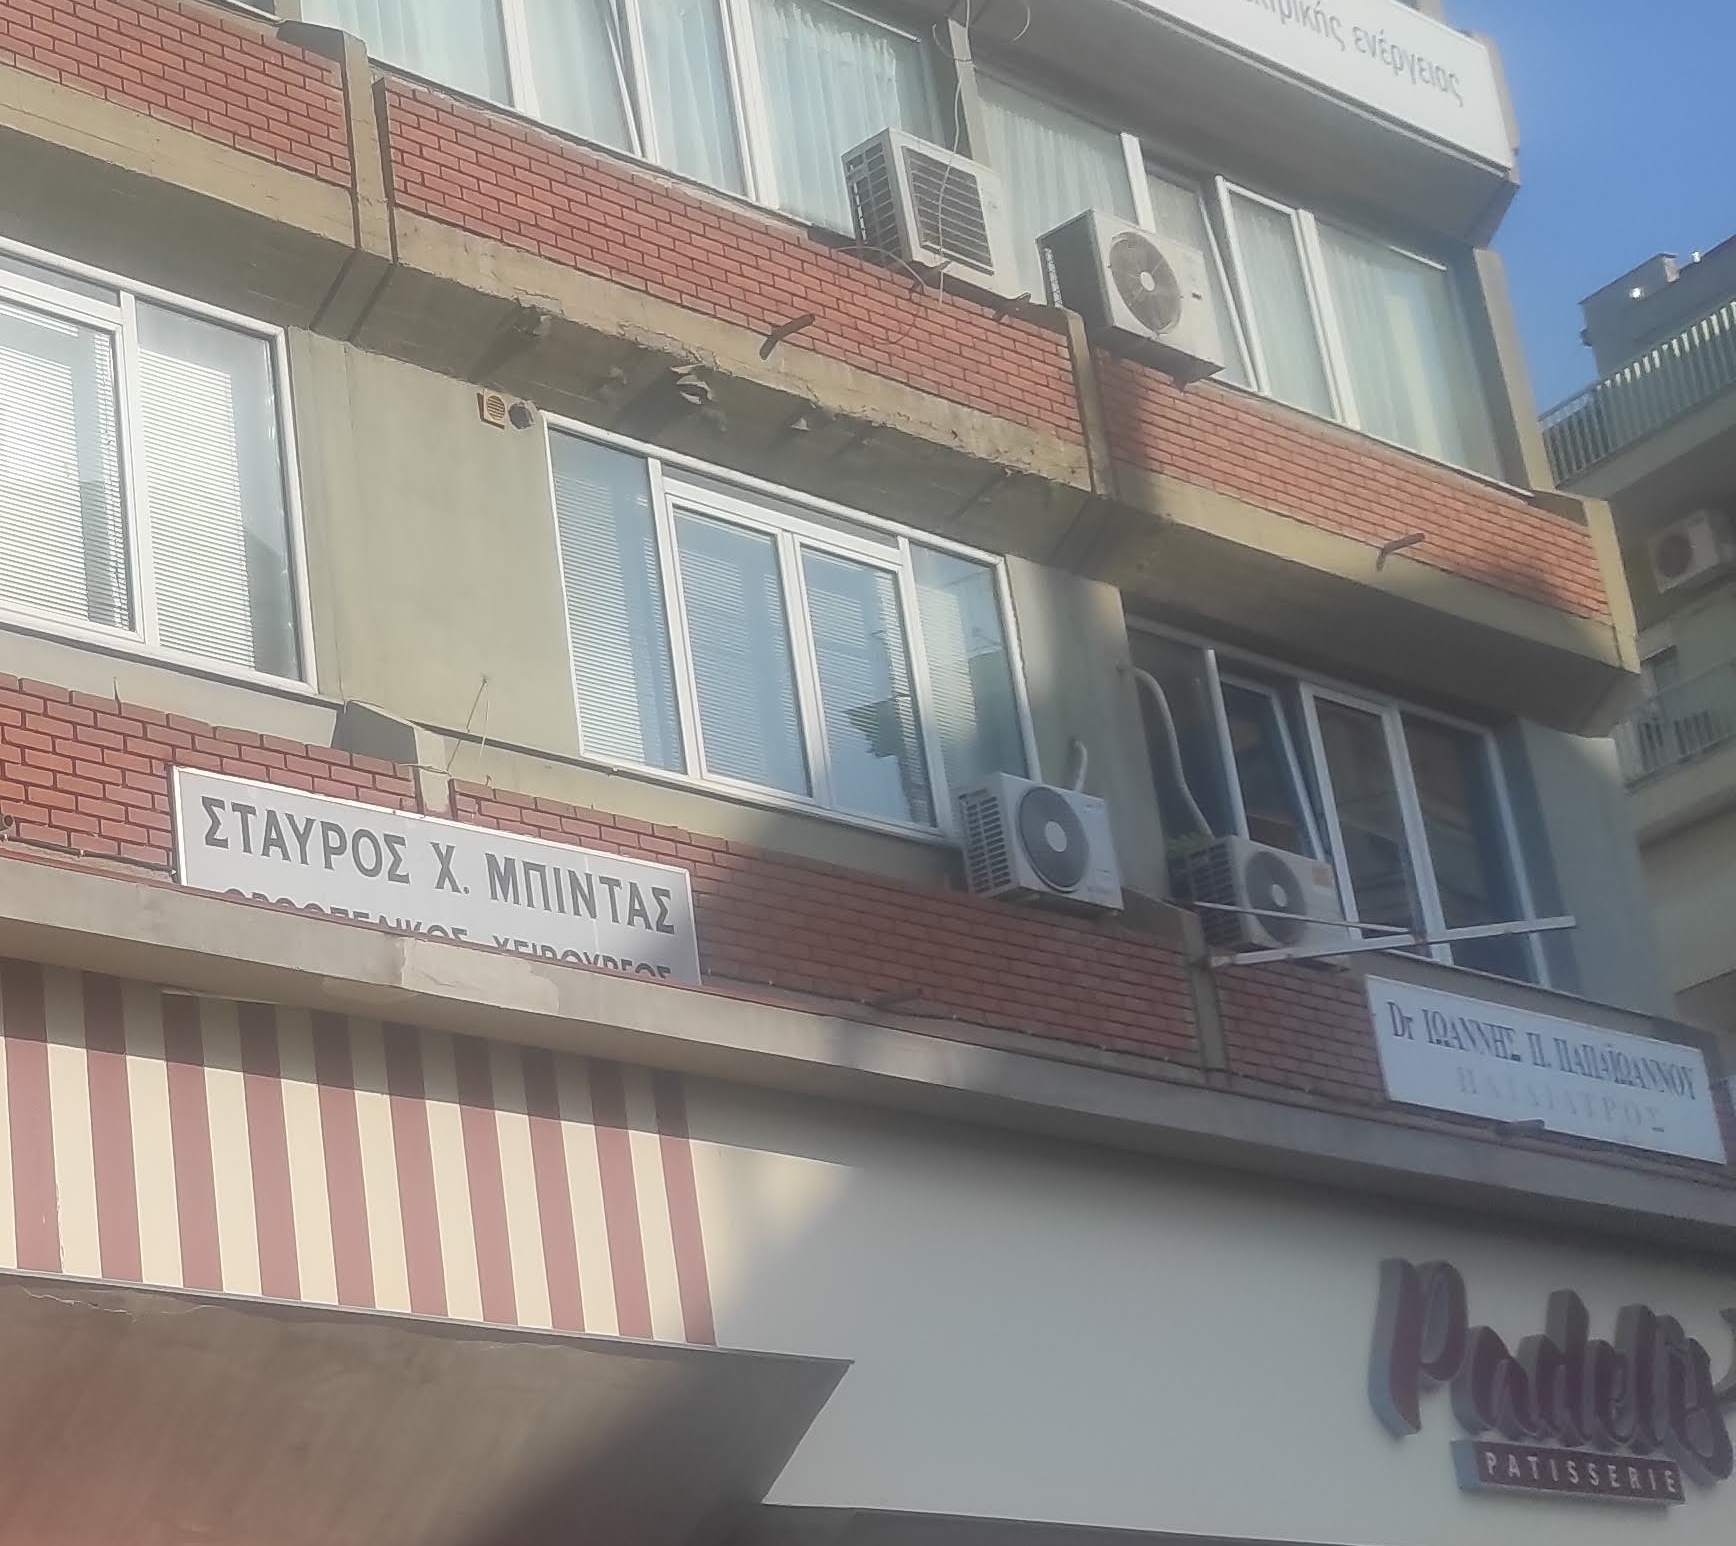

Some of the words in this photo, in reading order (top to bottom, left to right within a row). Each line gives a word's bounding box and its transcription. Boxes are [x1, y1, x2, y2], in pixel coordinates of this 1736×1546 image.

[1352, 24, 1464, 108] ενέργειας
[201, 796, 411, 885] ΣΤΑΥΡΟΣ
[430, 841, 471, 894] Χ.
[486, 853, 676, 935] ΜΠΙΝΤΑΣ
[1485, 1451, 1677, 1493] PATISSERIE
